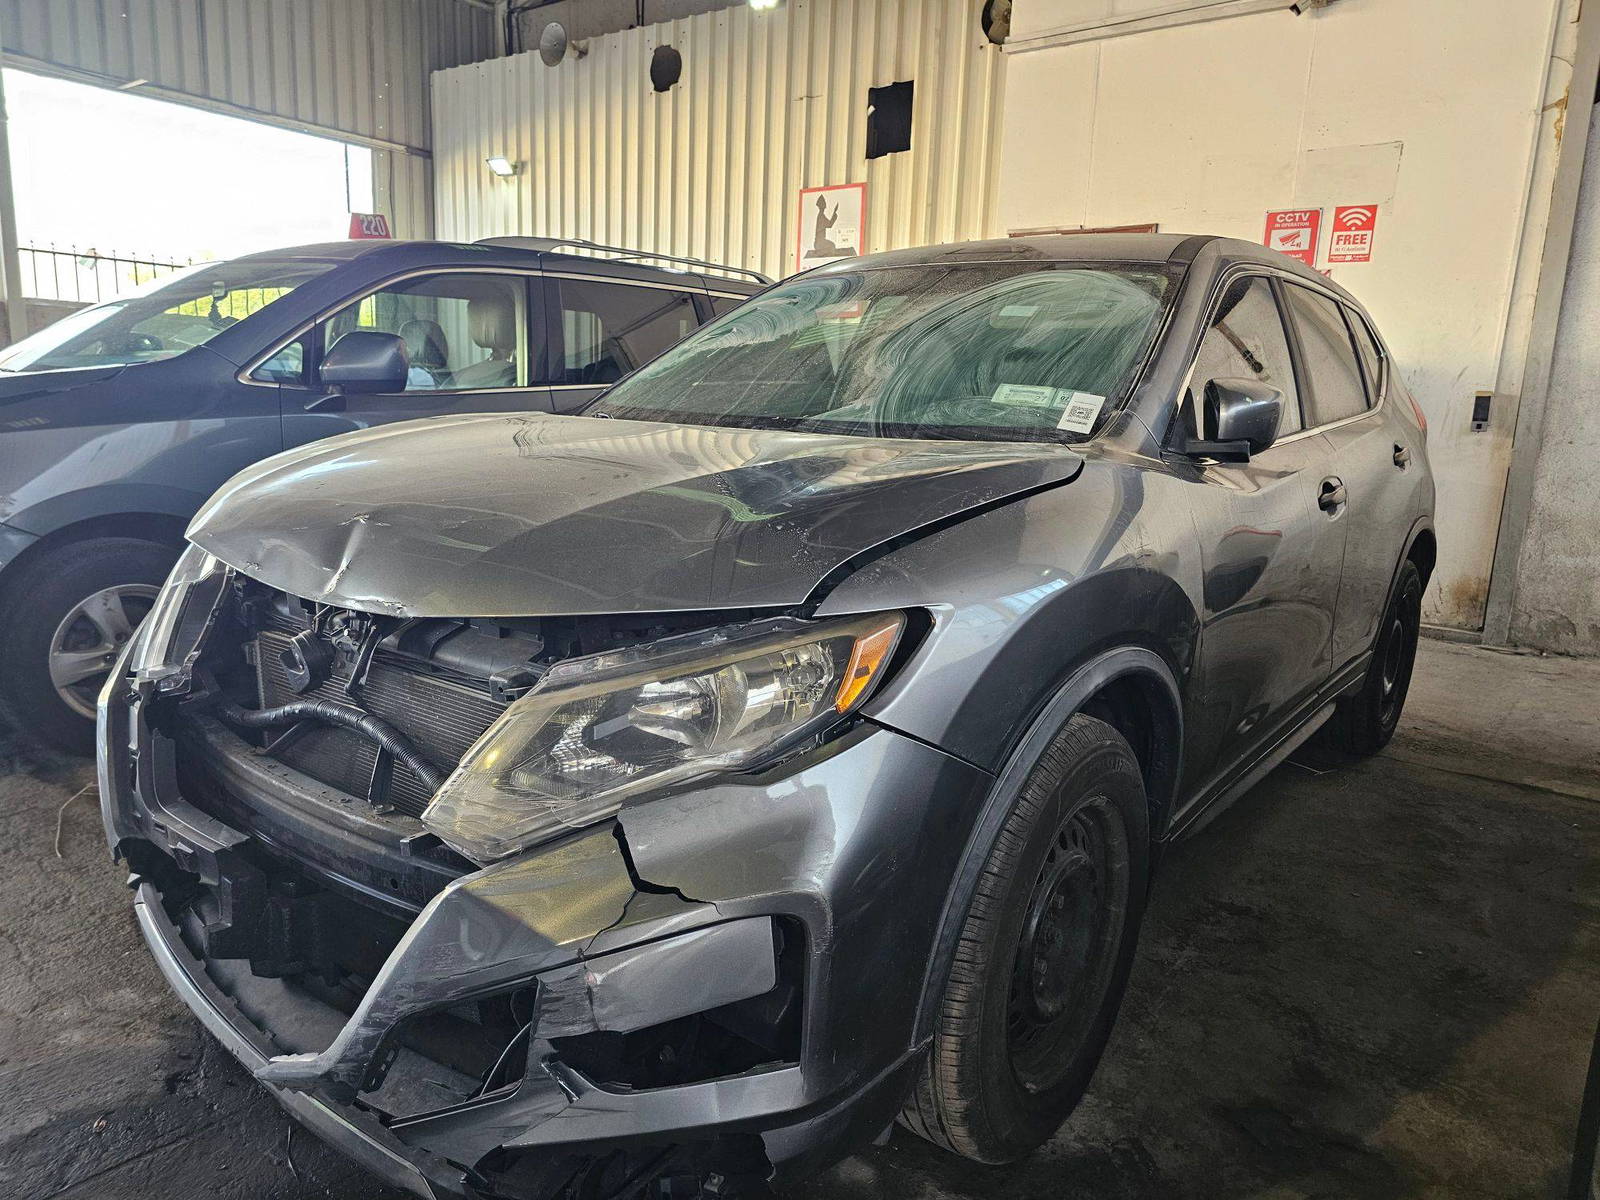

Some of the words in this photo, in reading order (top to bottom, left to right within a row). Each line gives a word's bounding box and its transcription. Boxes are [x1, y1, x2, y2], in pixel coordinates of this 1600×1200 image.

[1276, 212, 1310, 223] CCTV
[359, 214, 386, 236] 220
[1335, 233, 1368, 245] FREE
